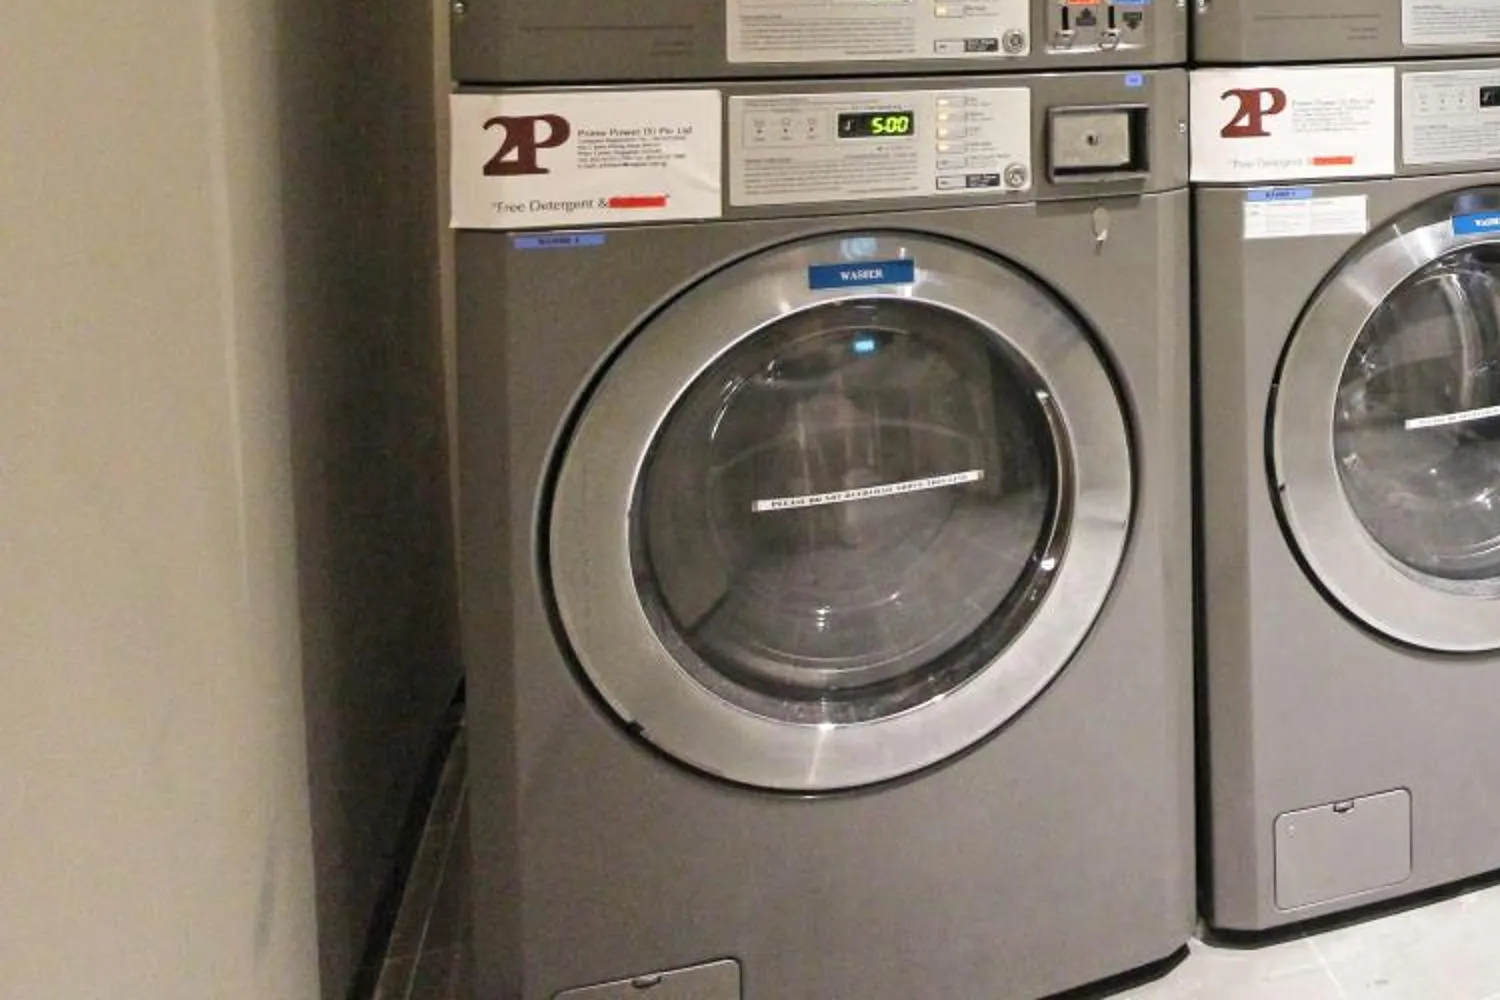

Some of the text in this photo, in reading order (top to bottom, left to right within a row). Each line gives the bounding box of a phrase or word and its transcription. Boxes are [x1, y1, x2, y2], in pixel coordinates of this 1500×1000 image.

[1220, 87, 1287, 138] 2P
[482, 113, 571, 177] 2P
[530, 198, 593, 214] Detergent
[840, 268, 884, 281] WASHER
